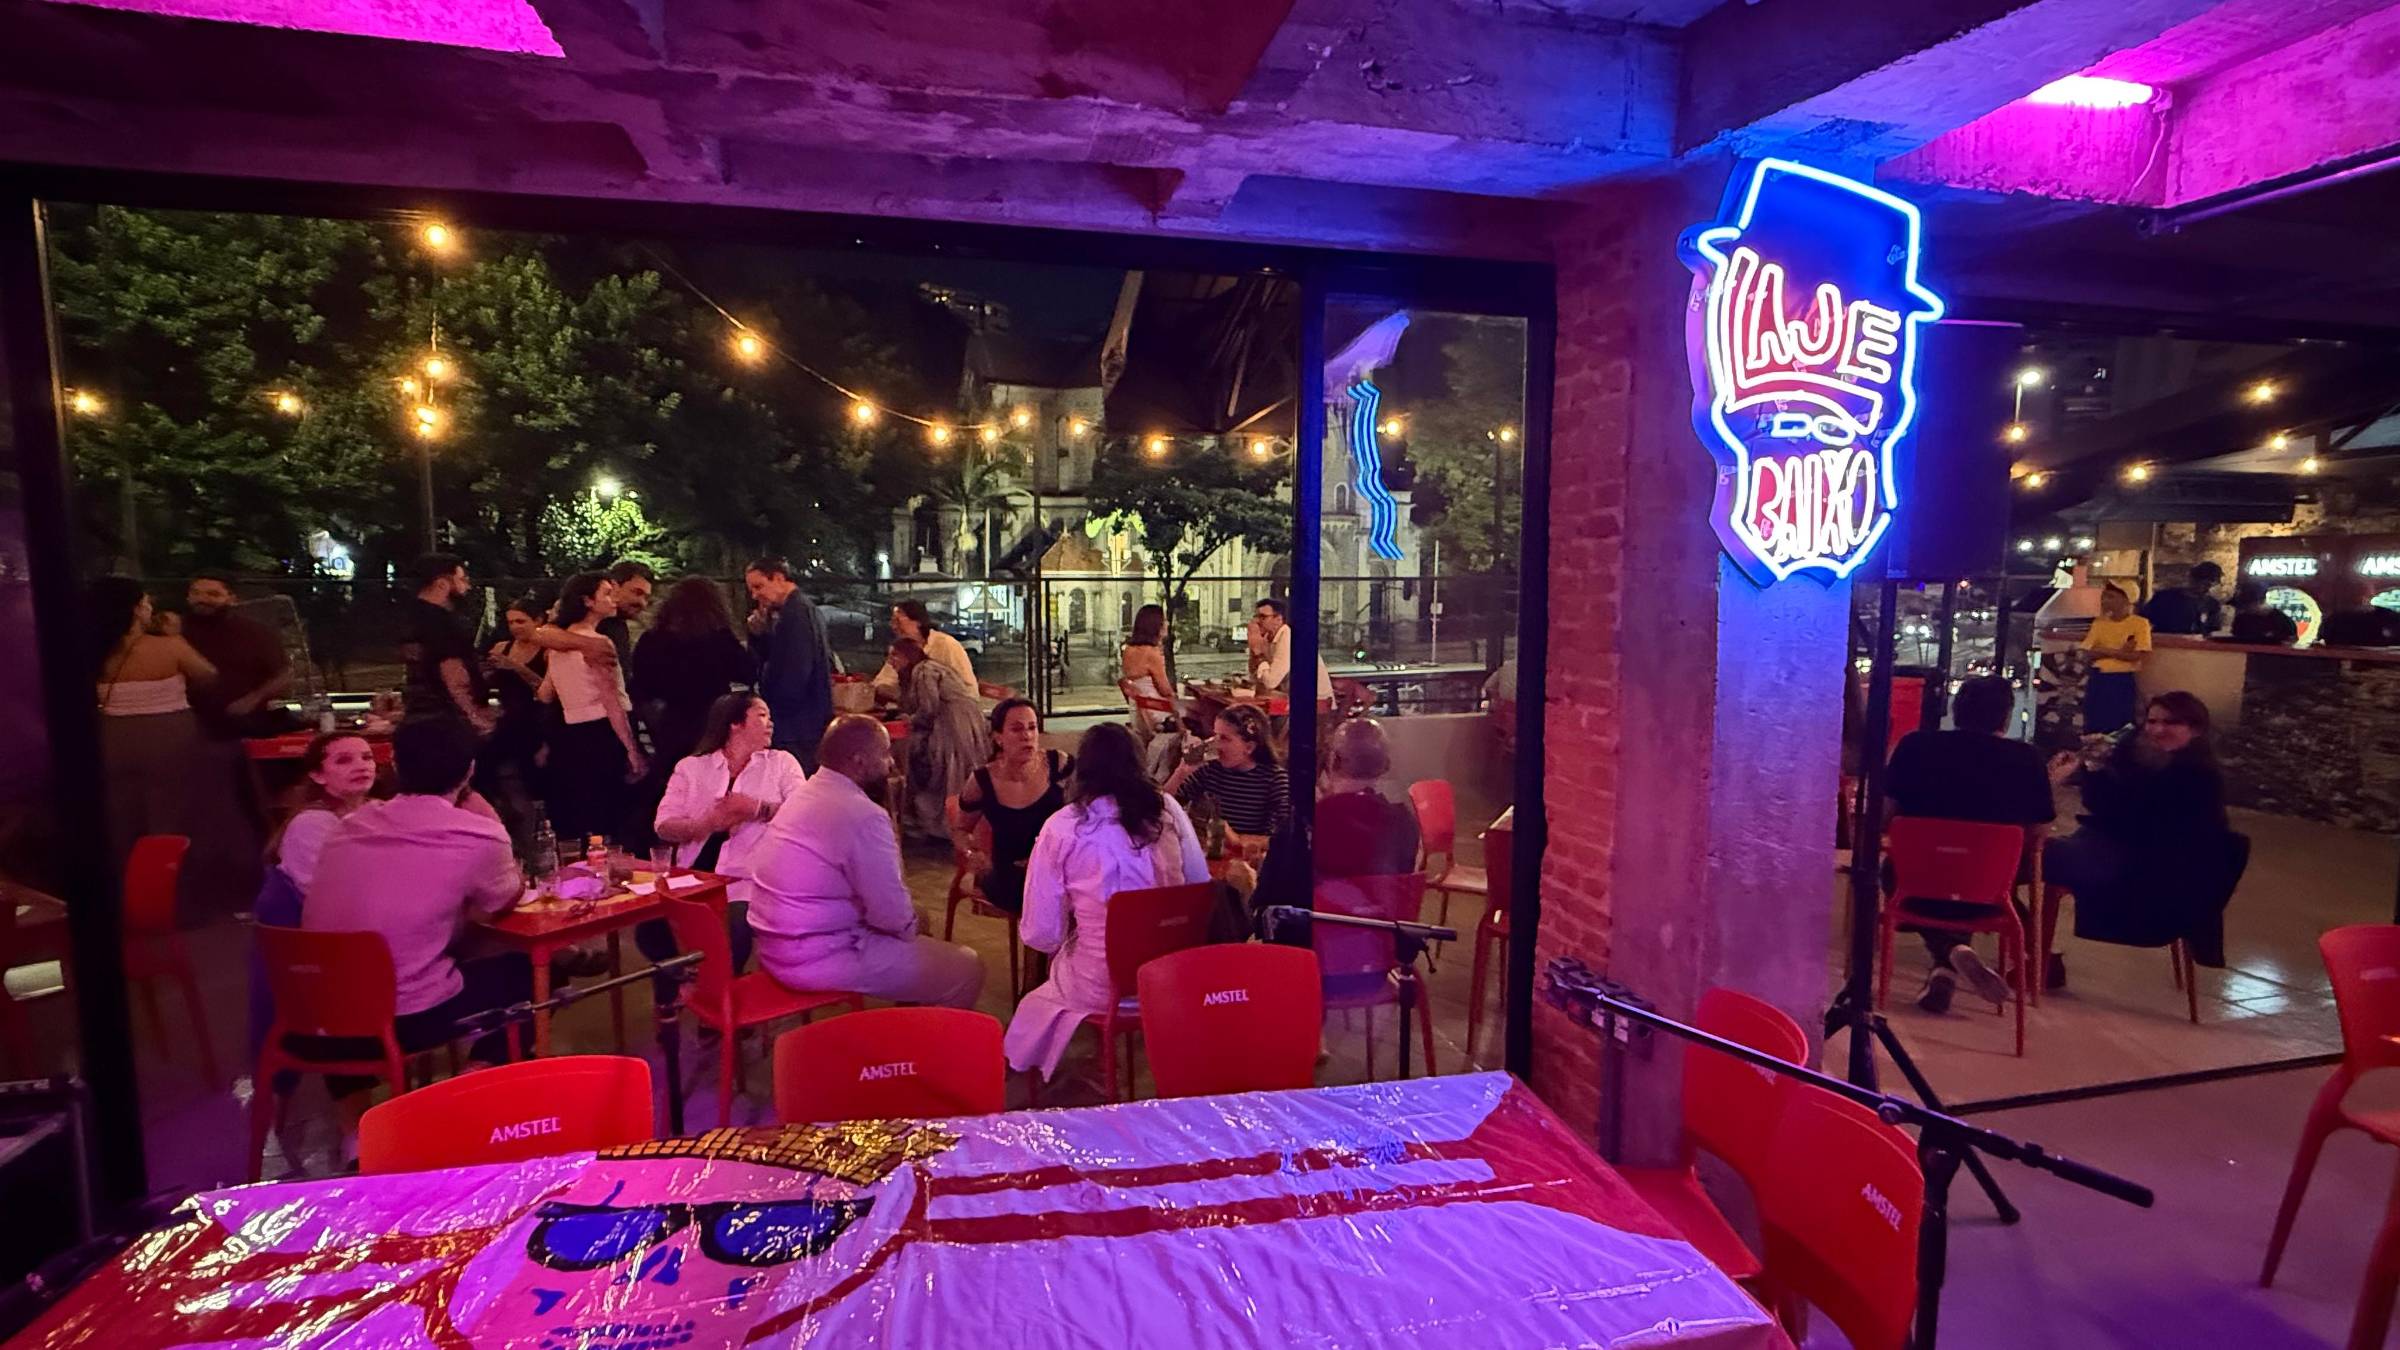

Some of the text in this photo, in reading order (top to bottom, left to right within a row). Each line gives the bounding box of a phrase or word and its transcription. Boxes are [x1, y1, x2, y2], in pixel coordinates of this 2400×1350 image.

[1720, 246, 1901, 435] LAJE
[1772, 412, 1856, 445] DO
[1747, 448, 1876, 560] BAIXO
[2248, 557, 2319, 576] AMSTEL
[1203, 989, 1250, 1007] AMSTEL
[859, 1061, 918, 1082] AMSTEL
[489, 1116, 562, 1145] AMSTEL
[1861, 1183, 1902, 1232] AMSTEL
